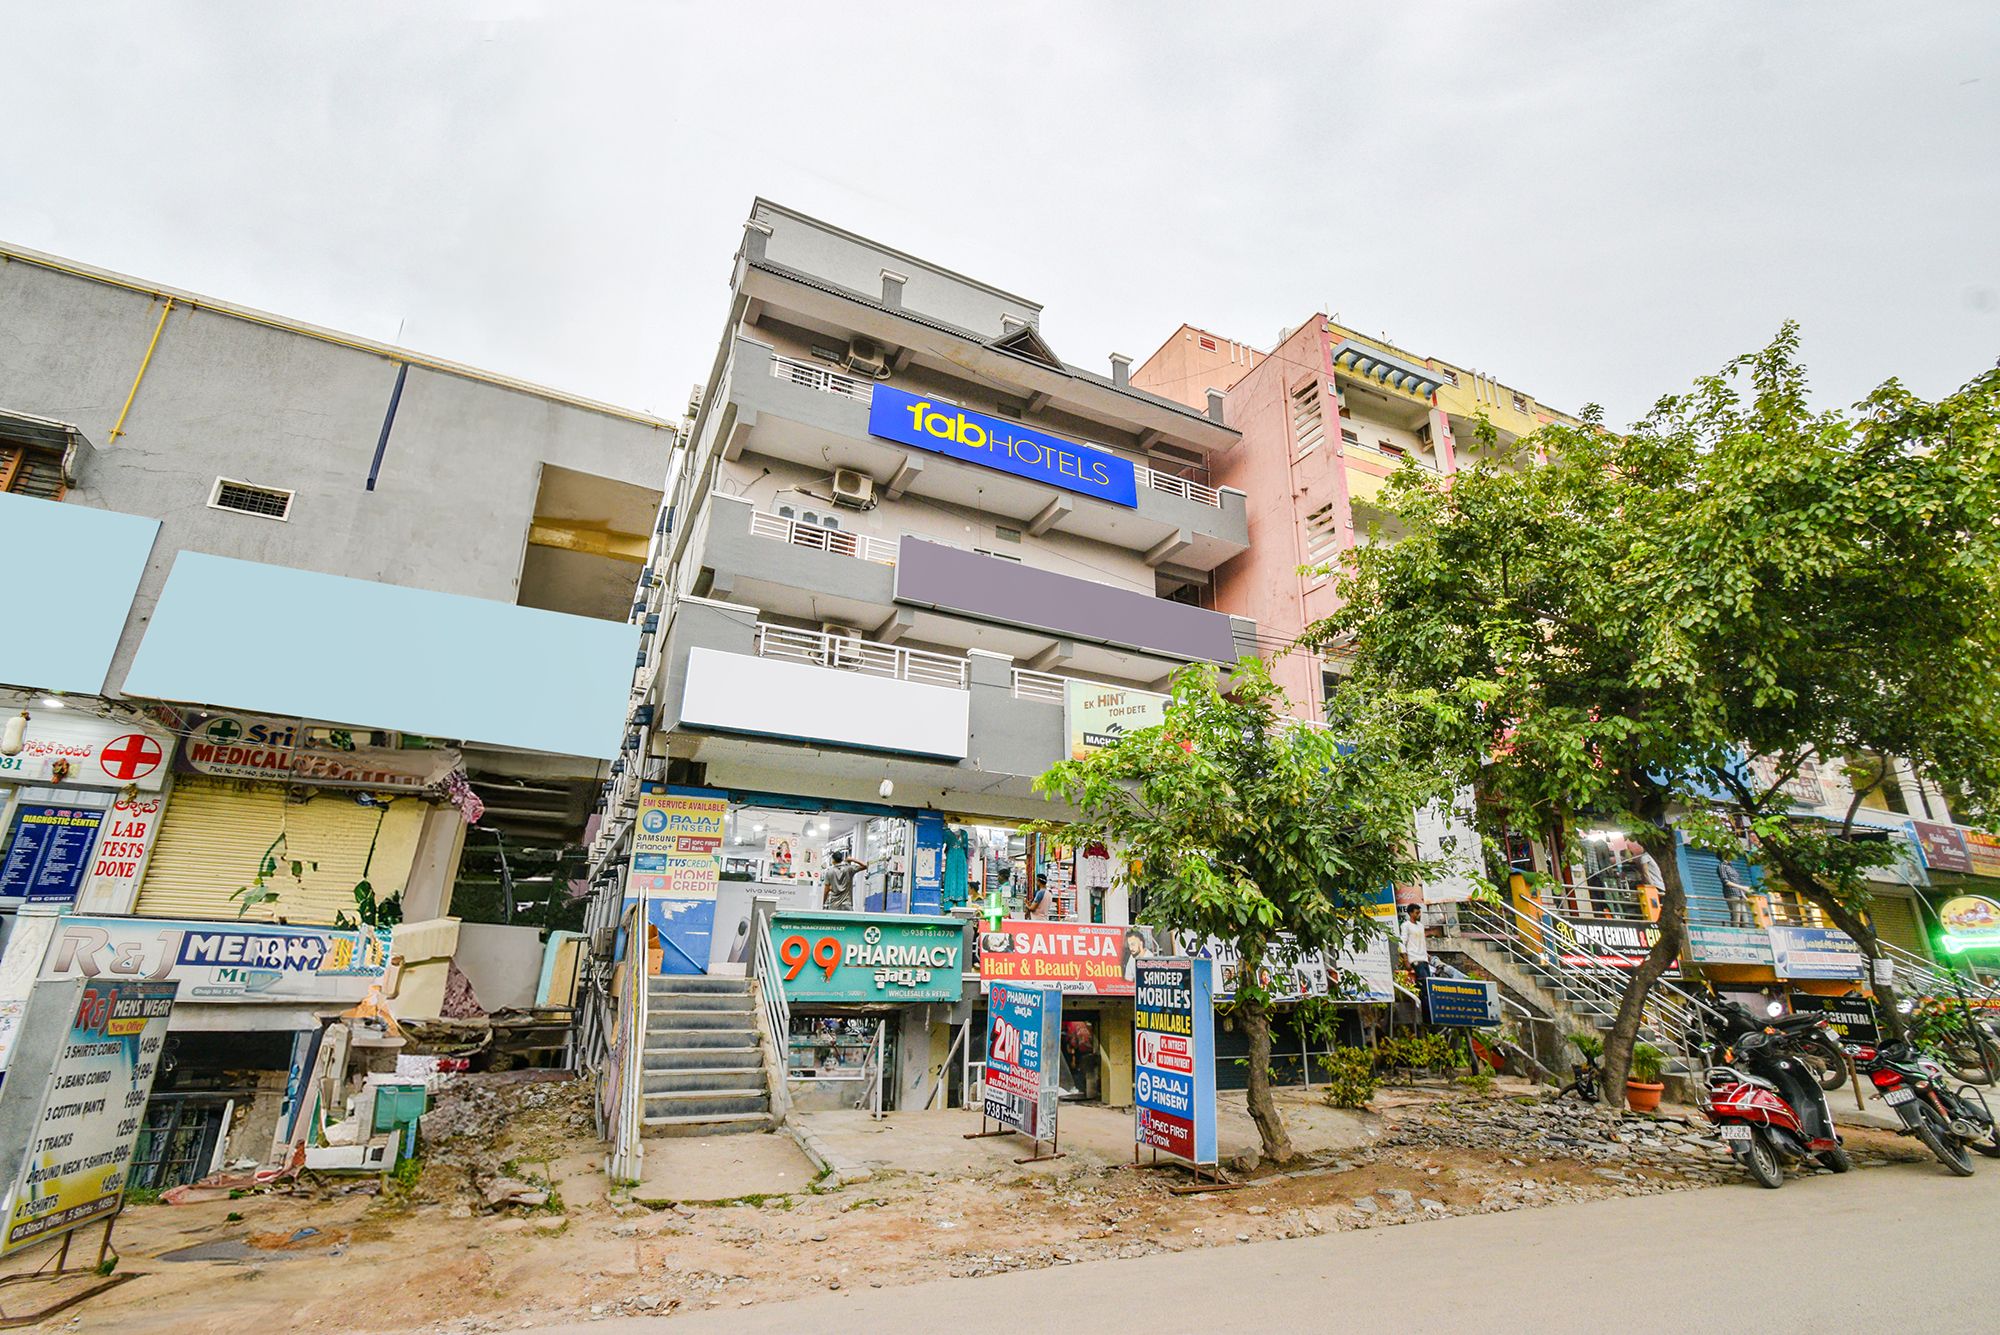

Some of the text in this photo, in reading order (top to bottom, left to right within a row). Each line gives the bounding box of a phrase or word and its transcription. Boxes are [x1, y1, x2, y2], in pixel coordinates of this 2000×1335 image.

[1084, 700, 1094, 709] EK
[1109, 705, 1146, 717] TOH DETE
[244, 724, 293, 747] Sri
[191, 743, 289, 770] MEDICAL
[658, 800, 686, 809] SERVICE
[688, 801, 724, 812] AVAILABLE
[22, 815, 99, 828] DIAGNOSTIC CENTRE
[669, 823, 719, 832] FINSERV
[671, 815, 720, 826] BAJAJ
[111, 821, 146, 838] LAB
[637, 833, 676, 842] SAMSUNG
[101, 842, 144, 858] TESTS
[95, 861, 136, 878] DONE
[674, 869, 713, 880] HOME
[673, 881, 717, 891] CREDIT
[1604, 926, 1640, 947] CENTRAL
[1015, 934, 1117, 957] SAITEJA
[780, 935, 957, 982] 99 PHARMACY
[984, 958, 1015, 976] Hair
[1020, 959, 1031, 976] &
[1035, 959, 1082, 981] Beauty
[1086, 960, 1122, 977] Salon
[1143, 971, 1183, 986] SANDEEP
[888, 990, 924, 998] WHOLESALE
[1006, 990, 1041, 1007] PHARMACY
[1137, 987, 1191, 1009] MOBILE'S
[113, 1000, 172, 1016] MENS WEAR
[127, 1020, 144, 1032] Offer
[1136, 1011, 1191, 1034] EMI AVAILABLE
[1830, 1012, 1871, 1024] CENTRAL
[64, 1046, 71, 1059] 3
[71, 1043, 97, 1058] SHIRTS
[97, 1041, 122, 1055] COMBO
[55, 1076, 62, 1089] 3
[61, 1072, 85, 1088] JEANS
[85, 1070, 111, 1085] COMBO
[1152, 1075, 1188, 1095] BAJAJ
[1152, 1091, 1188, 1111] FINSERV
[45, 1108, 52, 1121] 3
[52, 1102, 83, 1120] COTTON
[82, 1099, 106, 1115] PANTS
[1169, 1124, 1188, 1139] FIRST
[36, 1139, 43, 1153] 3
[43, 1132, 74, 1151] TRACKS
[26, 1172, 33, 1185] 4
[32, 1167, 60, 1184] ROUND
[61, 1161, 82, 1176] NECK
[82, 1152, 113, 1170] T-SHIRTS
[15, 1205, 23, 1219] 4
[23, 1194, 59, 1217] T-SHIRTS
[12, 1225, 26, 1239] Old
[26, 1220, 44, 1235] Stock
[72, 1205, 93, 1219] Shirts
